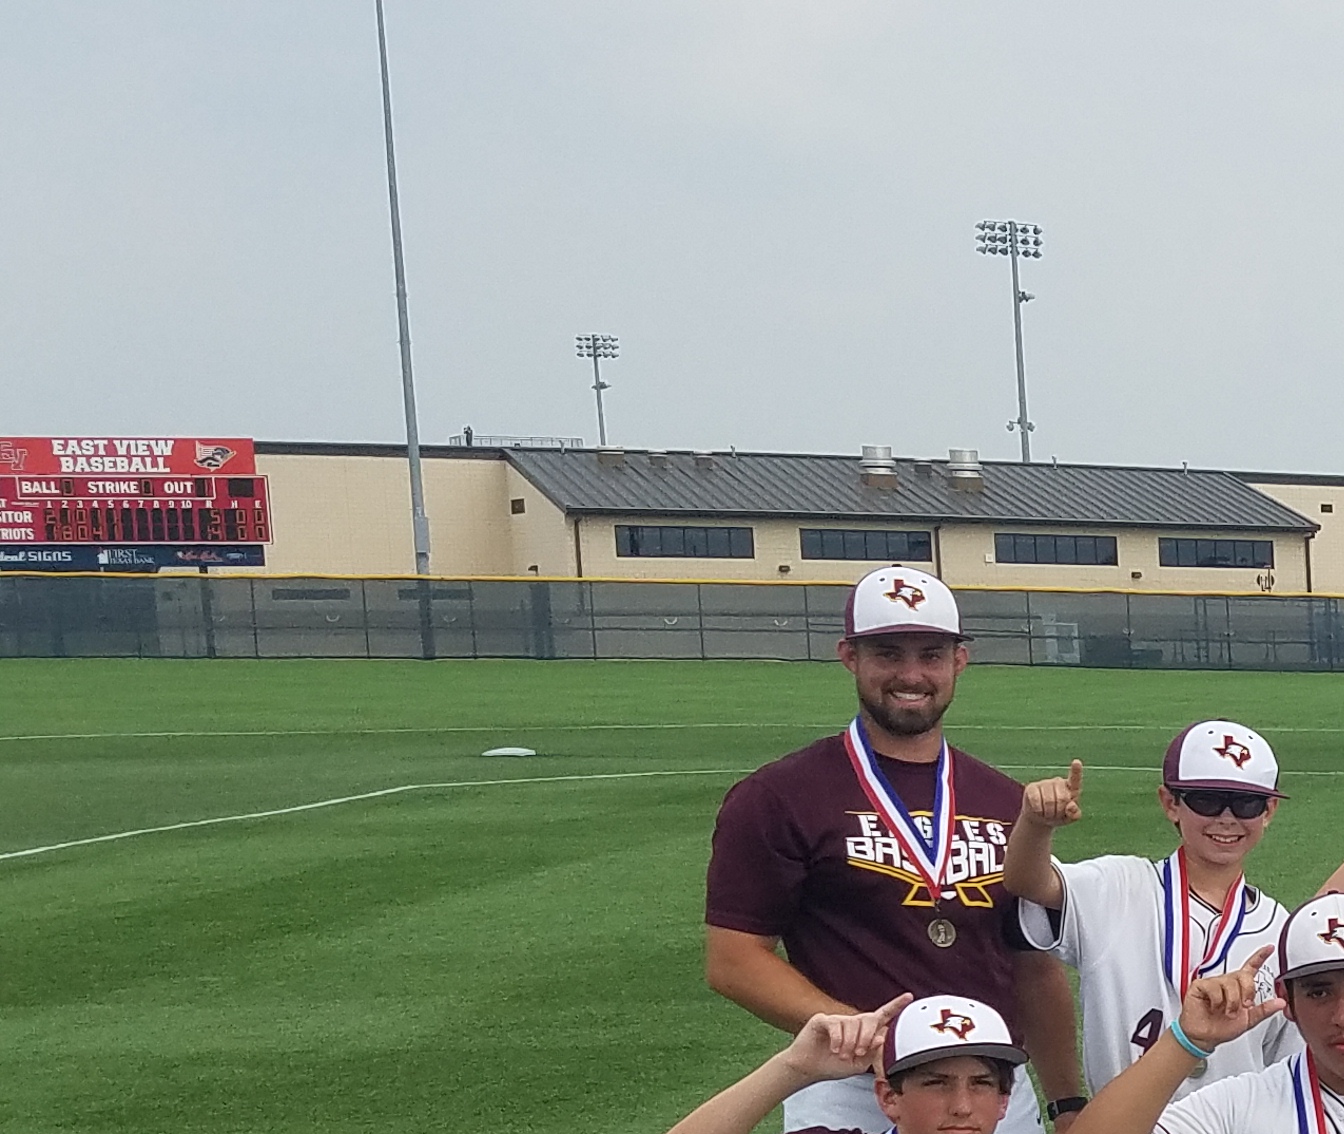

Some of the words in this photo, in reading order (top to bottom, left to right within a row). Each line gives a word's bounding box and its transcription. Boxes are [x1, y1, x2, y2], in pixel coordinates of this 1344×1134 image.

[51, 440, 108, 456] EAST
[113, 440, 174, 456] VIEW
[60, 457, 171, 473] BASEBALL
[21, 481, 60, 494] BALL
[87, 481, 139, 494] STRIKE
[164, 481, 193, 494] OUT
[46, 500, 53, 508] 1
[61, 500, 70, 508] 2
[76, 500, 84, 508] 3
[92, 500, 100, 508] 4
[107, 500, 115, 508] 5
[122, 500, 130, 508] 6
[137, 500, 144, 508] 7
[153, 500, 160, 508] 8
[168, 500, 175, 508] 9
[181, 500, 192, 508] 10
[205, 500, 213, 508] R
[1130, 1008, 1163, 1057] 4
